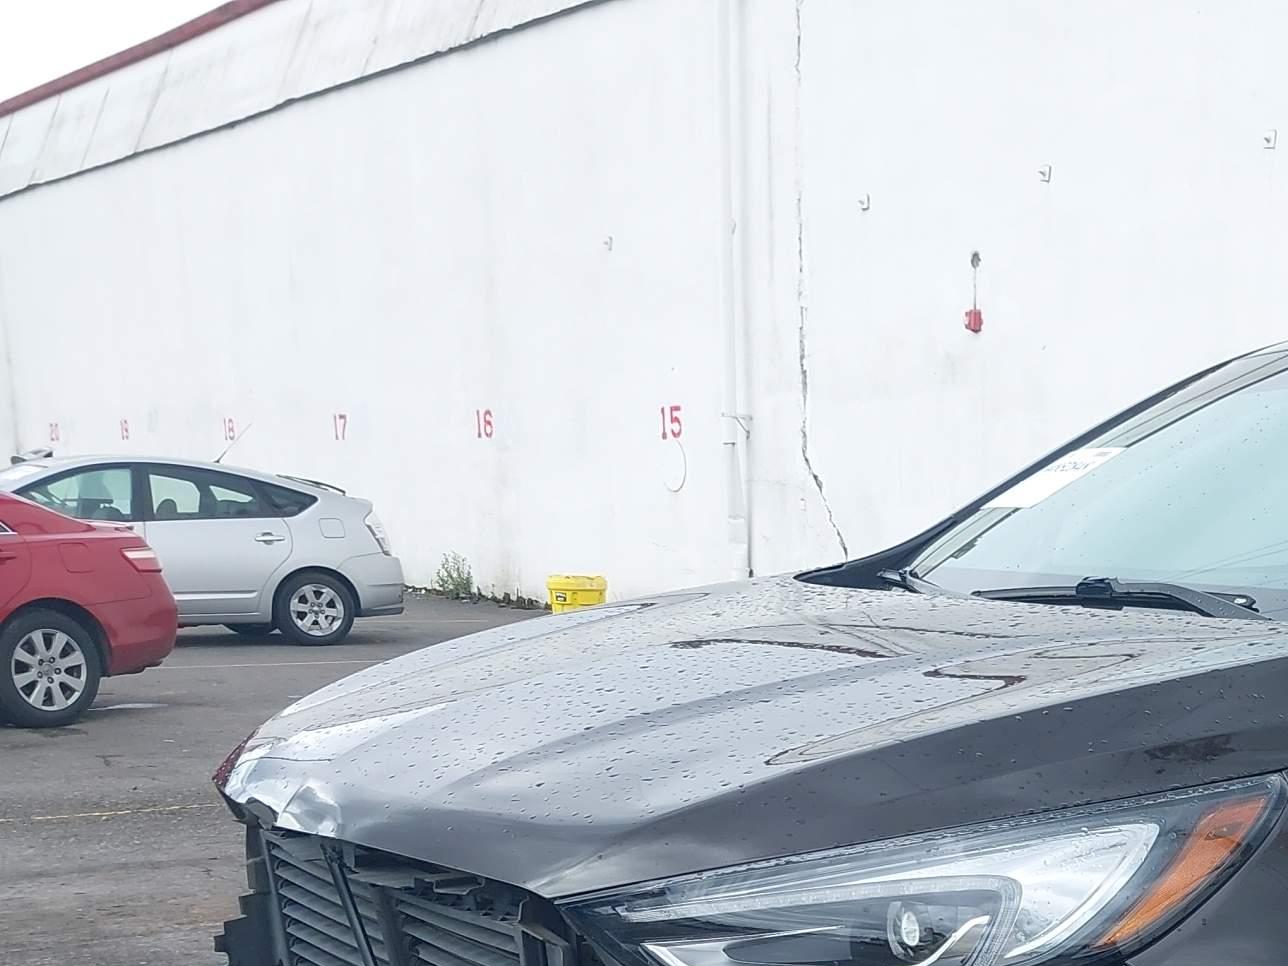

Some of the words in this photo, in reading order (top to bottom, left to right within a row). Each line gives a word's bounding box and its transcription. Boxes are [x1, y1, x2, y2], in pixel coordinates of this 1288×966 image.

[223, 417, 236, 441] 18
[333, 413, 348, 441] 17
[477, 409, 496, 438] 16
[660, 404, 683, 440] 15
